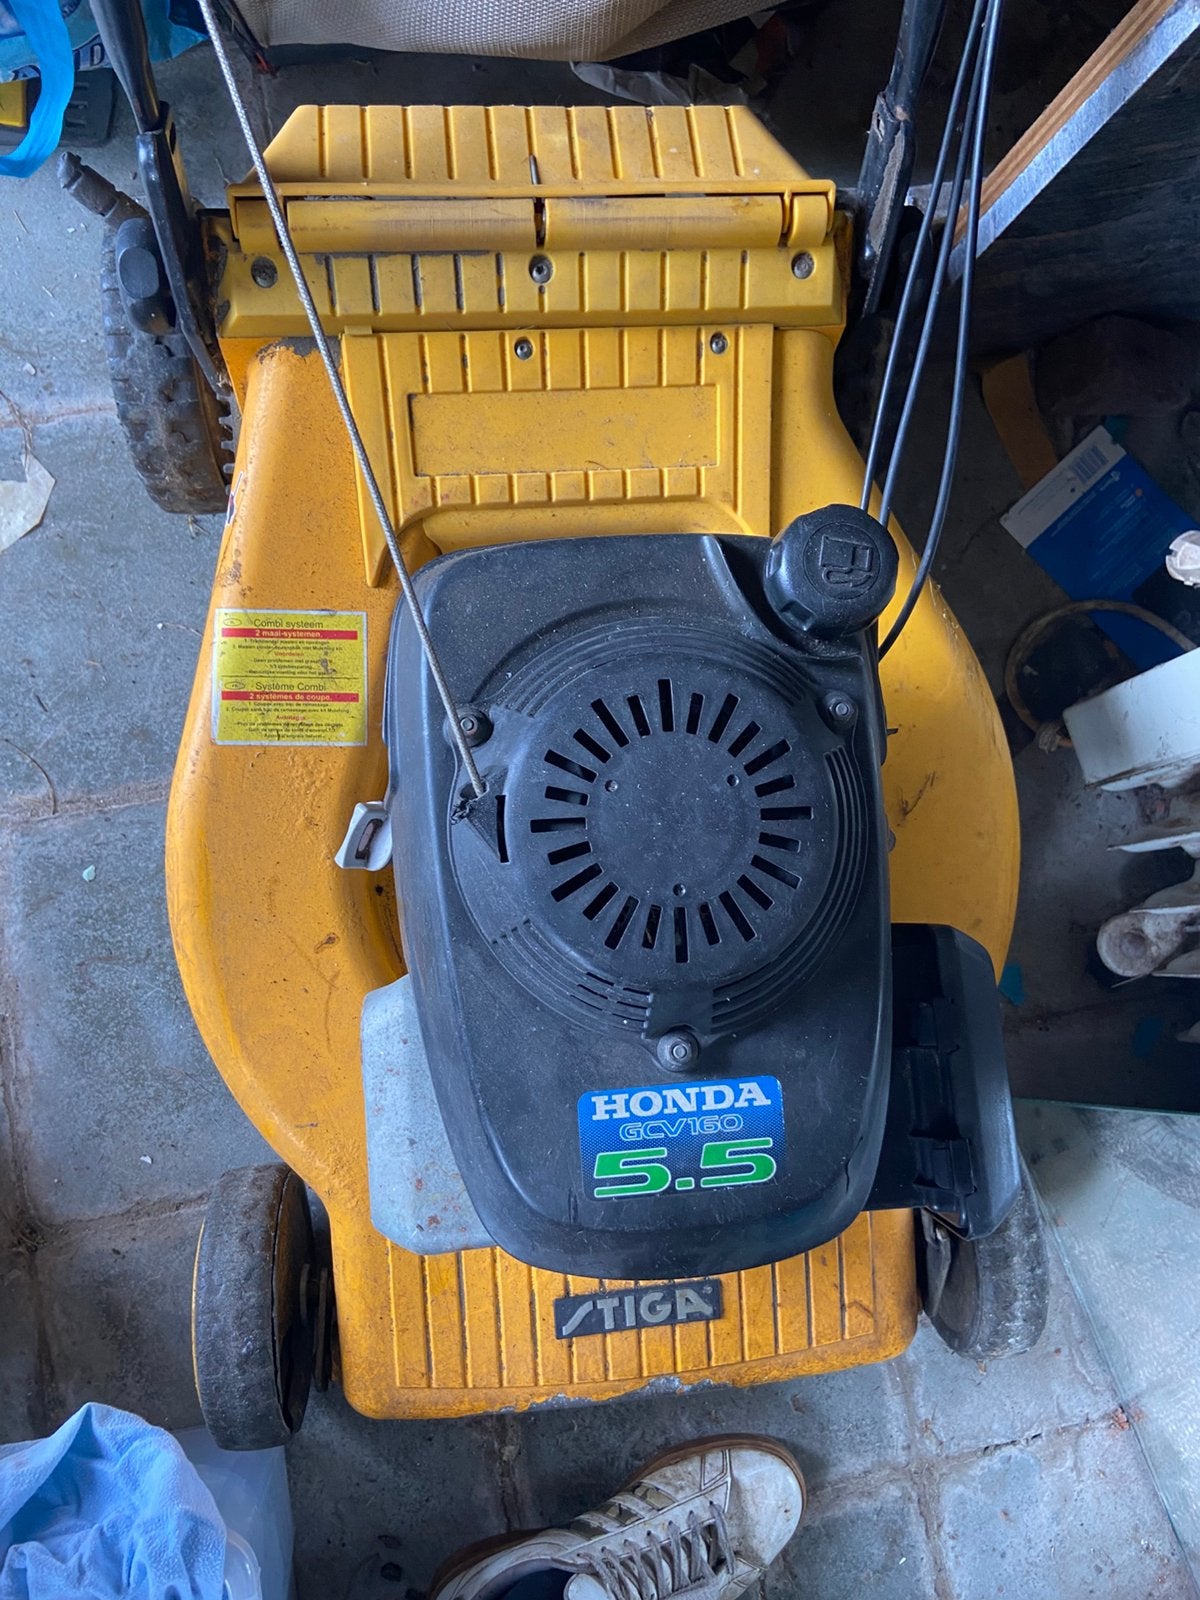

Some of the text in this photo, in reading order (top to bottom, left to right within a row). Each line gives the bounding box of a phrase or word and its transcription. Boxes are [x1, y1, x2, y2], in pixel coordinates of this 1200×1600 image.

[254, 619, 323, 628] Combi systeem
[256, 682, 326, 692] Système Combi
[591, 1081, 772, 1121] HONDA
[619, 1113, 743, 1141] GCV160
[593, 1137, 777, 1198] 5.5
[562, 1288, 714, 1336] STIGA
